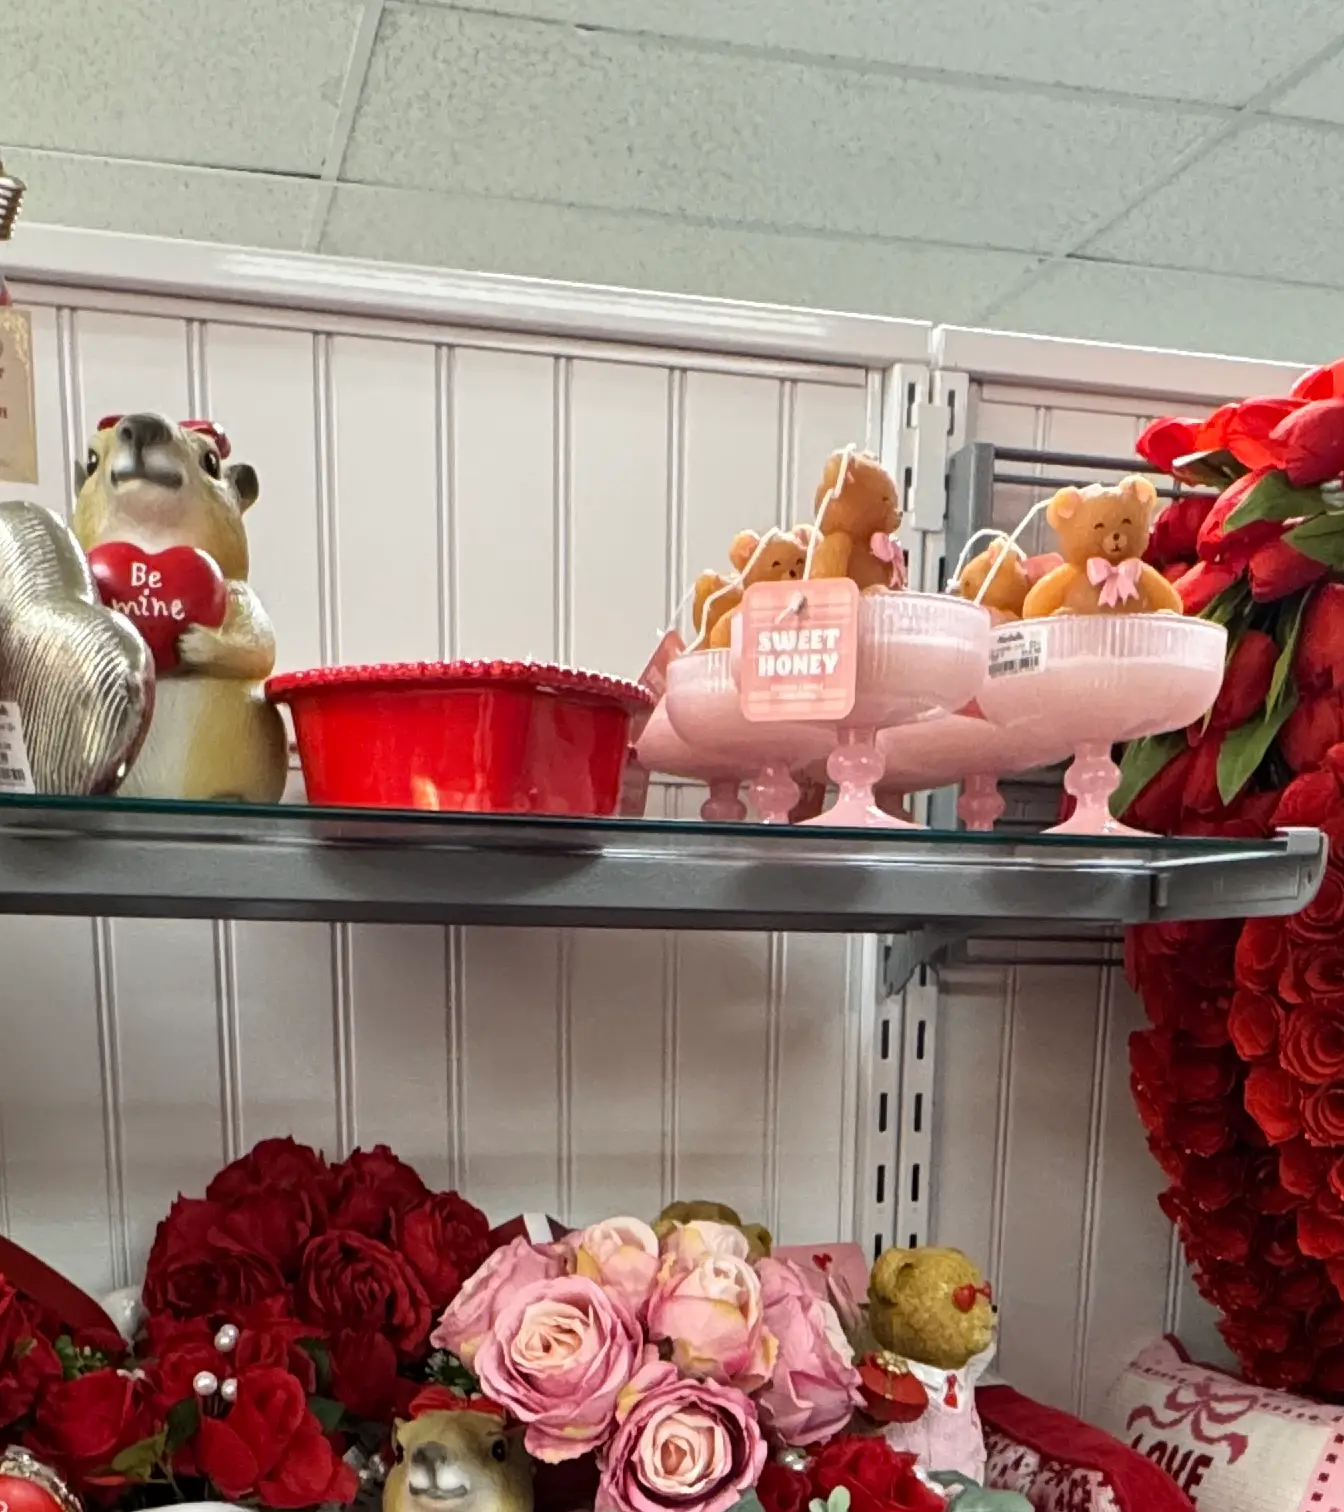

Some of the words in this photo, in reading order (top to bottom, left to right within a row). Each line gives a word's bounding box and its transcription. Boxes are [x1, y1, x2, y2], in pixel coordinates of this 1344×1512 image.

[131, 561, 163, 588] Be
[113, 588, 186, 620] mine
[758, 628, 840, 651] SWEET
[758, 652, 839, 677] HONEY
